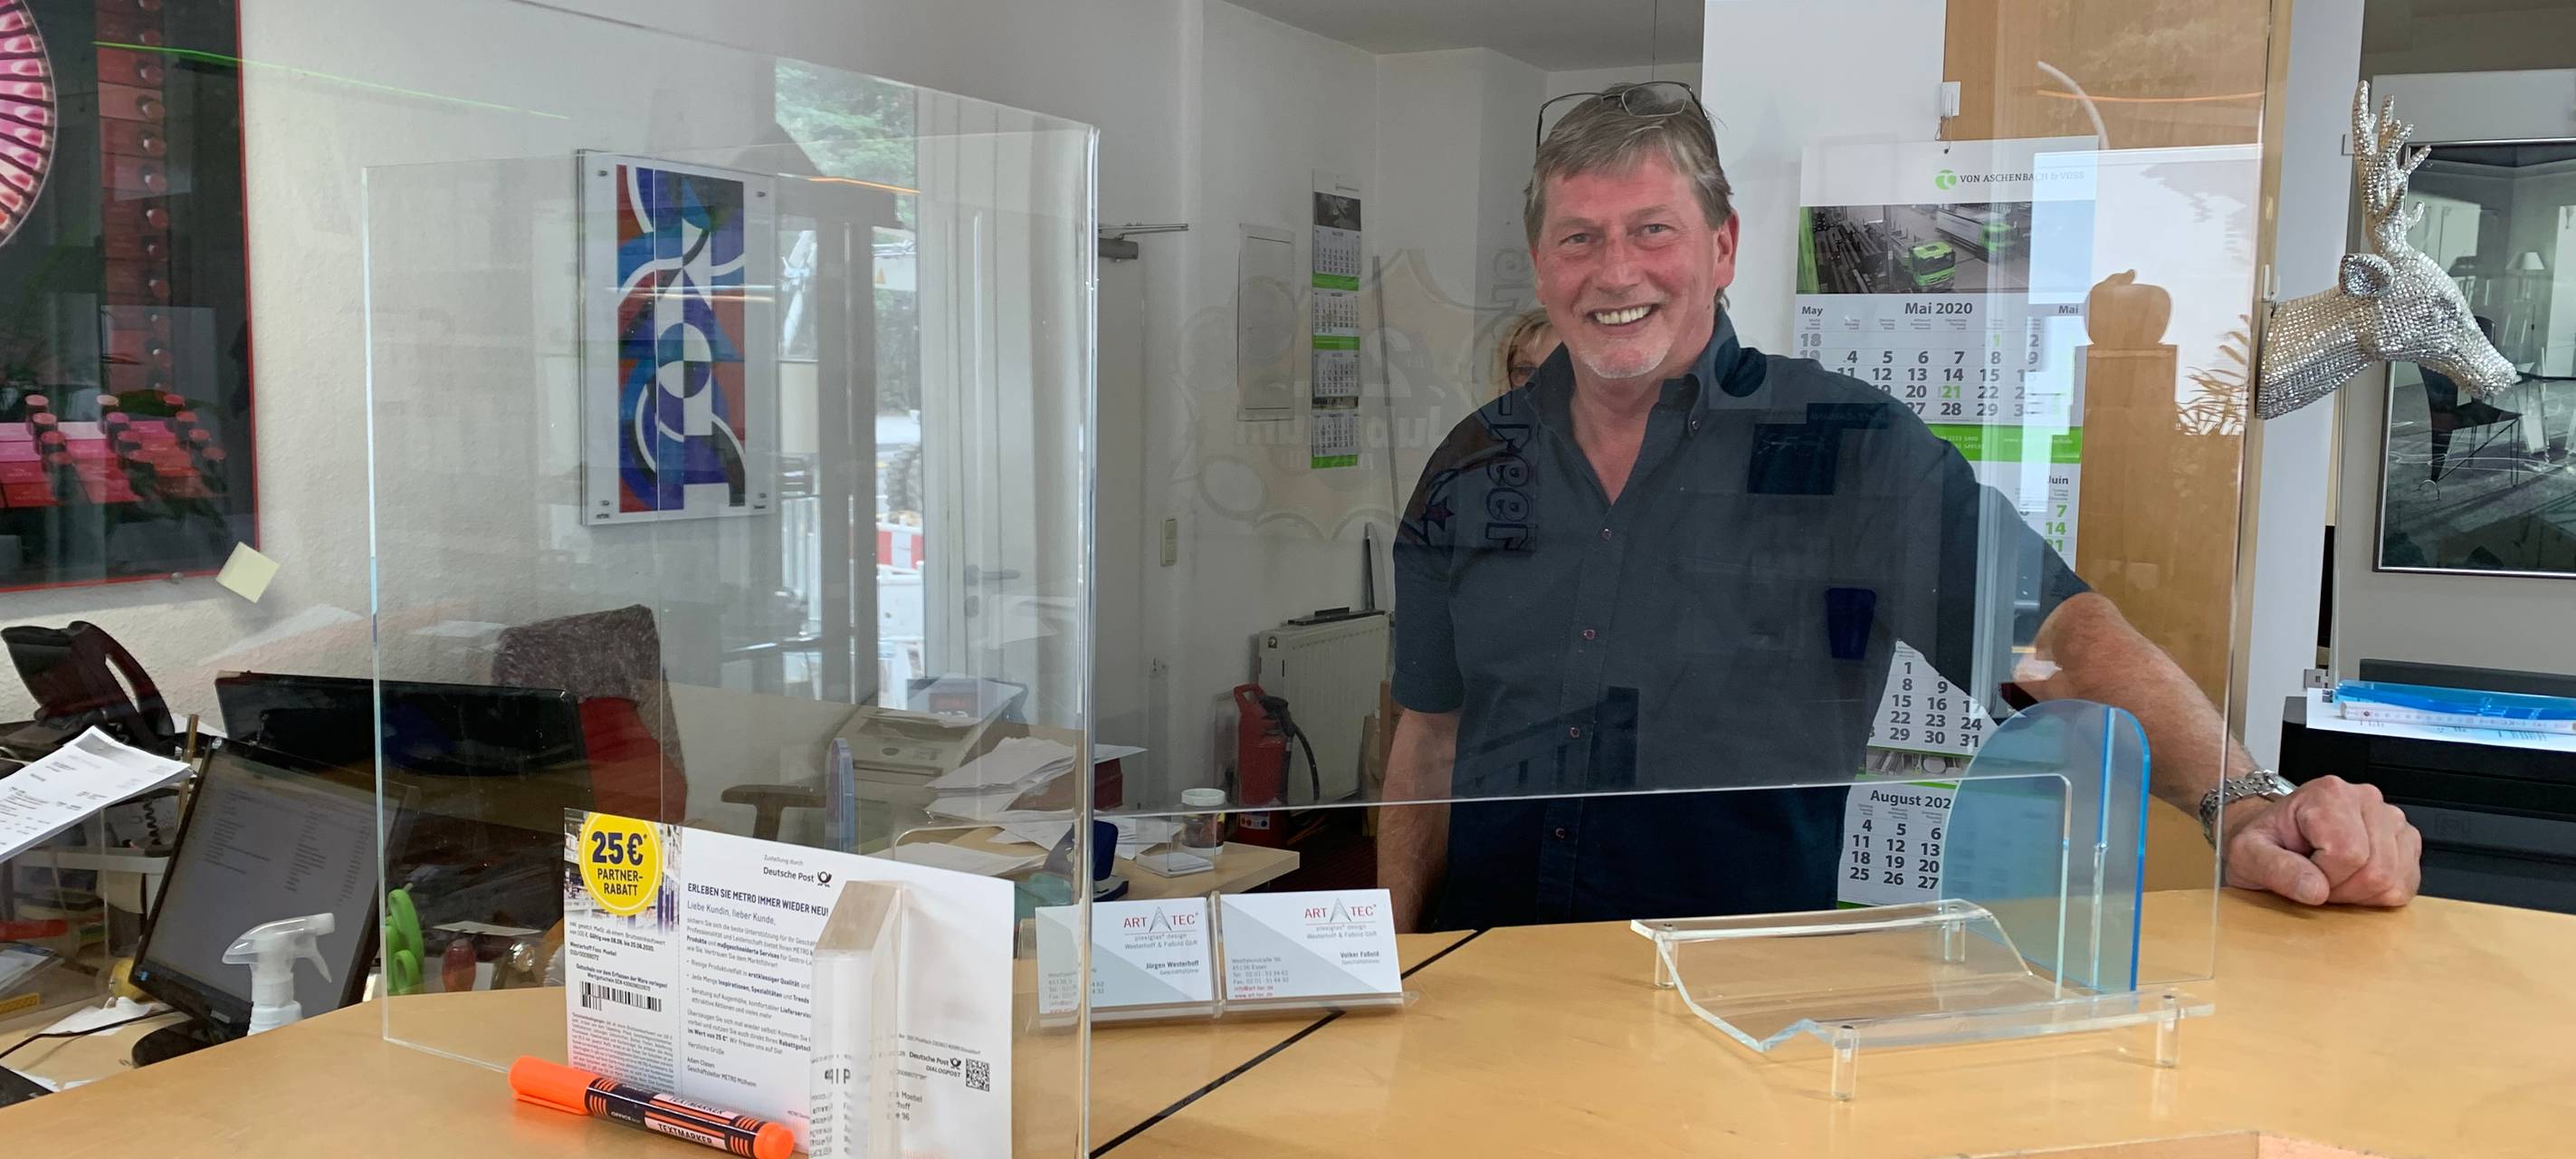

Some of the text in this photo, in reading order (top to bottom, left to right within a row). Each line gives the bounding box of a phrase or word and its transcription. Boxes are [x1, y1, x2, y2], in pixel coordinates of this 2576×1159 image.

[1960, 175, 1980, 183] VON
[1801, 302, 2078, 316] May Mai 2020 Mai
[1801, 333, 1822, 347] 18
[2029, 334, 2039, 347] 2
[1847, 350, 1858, 363] 4
[1883, 350, 1893, 364] 5
[1918, 350, 1929, 364] 6
[1954, 351, 1965, 364] 7
[1991, 351, 2001, 364] 8
[2028, 351, 2038, 364] 9
[1872, 368, 1892, 381] 12
[1907, 368, 1927, 381] 13
[1943, 369, 1964, 381] 14
[1980, 369, 2000, 381] 15
[1905, 385, 1999, 399] 20 21 22
[1941, 403, 1962, 416] 28
[1977, 403, 1999, 417] 29
[2056, 504, 2067, 518] 7
[2046, 522, 2066, 535] 14
[1904, 662, 1912, 675] 1
[1902, 678, 1948, 694] 8 9
[1892, 694, 1912, 708] 15
[1927, 697, 1947, 711] 16
[1890, 711, 1982, 731] 22 23 24
[1889, 727, 1910, 741] 29
[1924, 730, 1945, 744] 30
[1960, 733, 1980, 747] 31
[1870, 790, 1951, 809] August 202
[1862, 819, 1942, 840] 4 5 6
[1852, 834, 1941, 857] 11 12 13
[1852, 850, 1940, 873] 18 19 20
[597, 868, 644, 883] PARTNER-
[763, 867, 815, 883] Deutsche Post
[1849, 867, 1940, 890] 25 26 27
[604, 883, 638, 896] RABATT
[688, 882, 829, 917] ERLEBEN SIE METRO IMMER WIEDER NEU!
[687, 900, 777, 926] Liebe Kundin, lieber Kunde,
[1304, 907, 1327, 919] ART
[1123, 916, 1148, 928] ART
[1340, 951, 1359, 959] Volker
[1146, 960, 1199, 971] Jürgen Westerhoff
[909, 1051, 949, 1067] Deutsche Post
[925, 1065, 961, 1078] DIALOGPOST
[657, 1123, 712, 1145] TEXTMARKER
